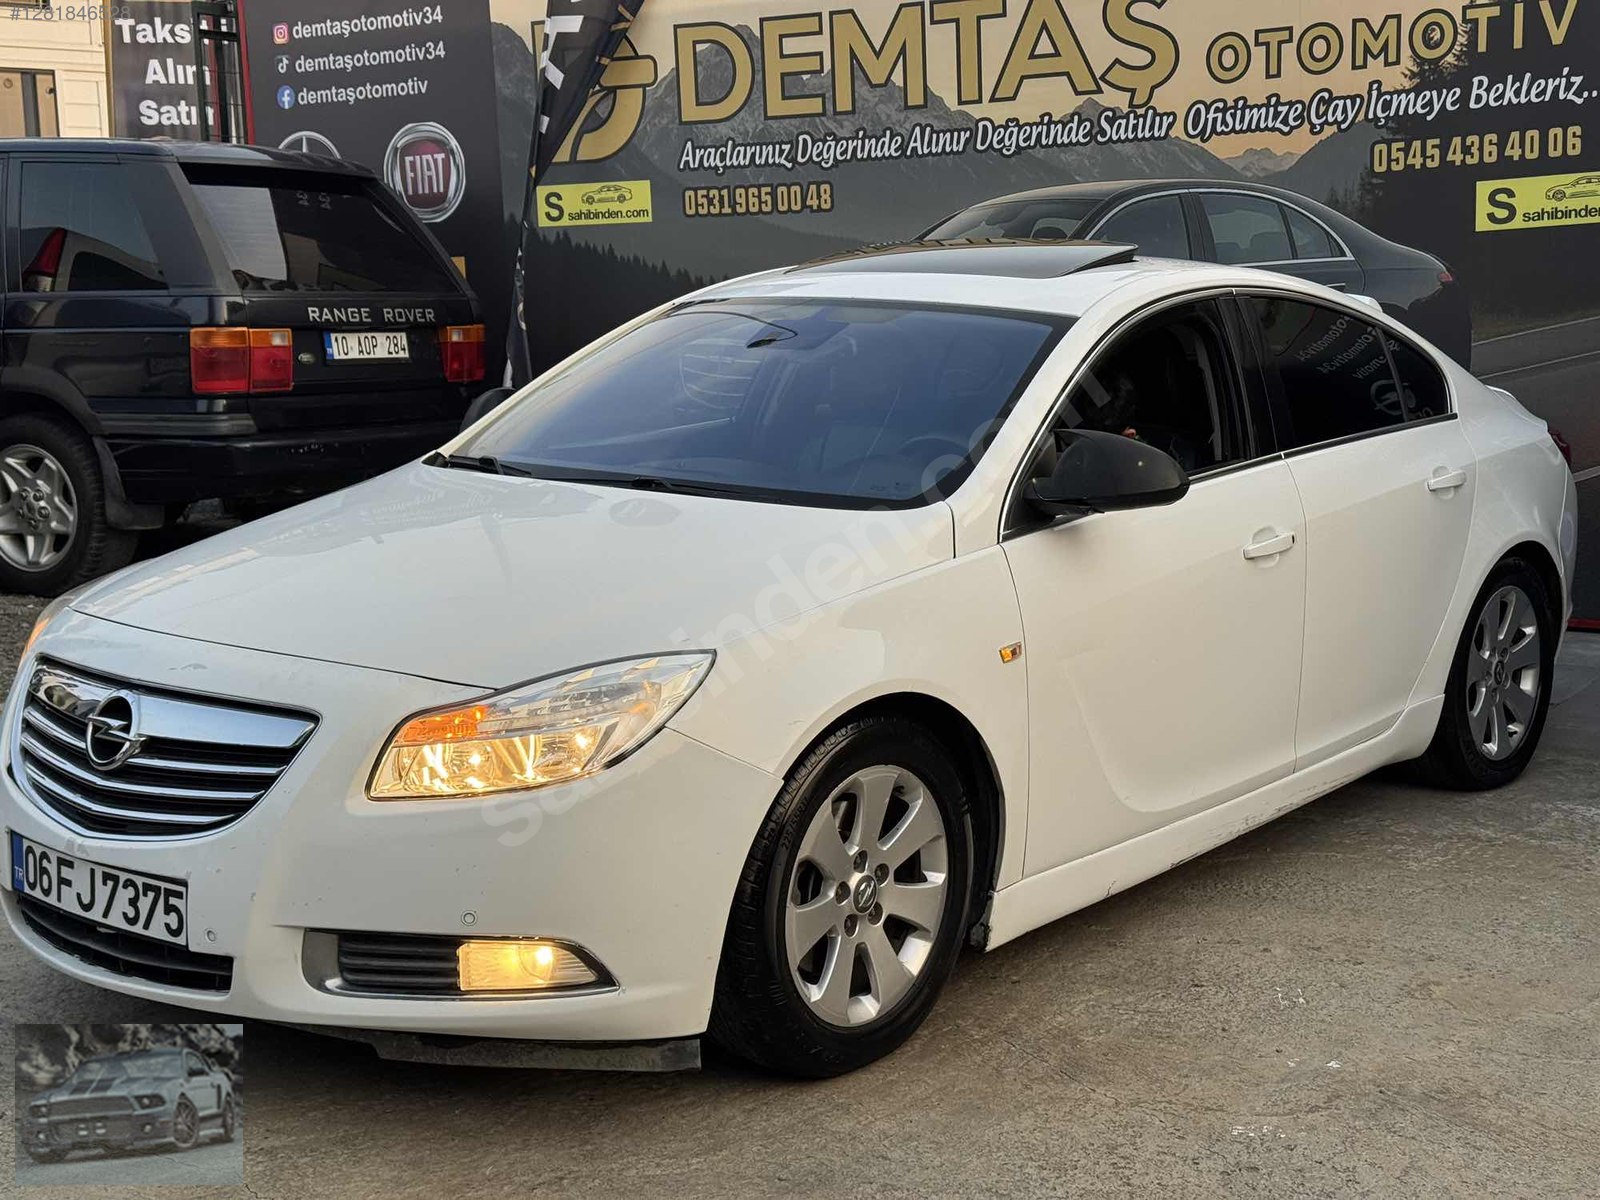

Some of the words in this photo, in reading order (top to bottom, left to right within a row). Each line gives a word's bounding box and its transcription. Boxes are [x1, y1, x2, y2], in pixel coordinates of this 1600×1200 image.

[292, 5, 443, 38] demtaşotomotiv34
[294, 41, 446, 72] demtaşotomotiv34
[673, 0, 1180, 125] DEMTAŞ
[297, 77, 428, 104] demtaşotomotiv
[679, 140, 793, 174] Araçlarınız
[796, 130, 901, 168] Değerinde
[906, 126, 970, 156] Alınır
[976, 116, 1091, 155] Değerinde
[1097, 109, 1174, 142] Satılır
[1187, 96, 1302, 140] Ofisimize
[1310, 91, 1361, 132] Çay
[1368, 83, 1461, 125] İçmeye
[1373, 138, 1441, 173] 0545
[1446, 133, 1498, 166] 436
[1504, 129, 1540, 160] 40
[1548, 125, 1582, 158] 06
[404, 153, 445, 195] FIAT
[568, 208, 649, 221] sahibinden.com
[684, 187, 731, 216] 0531
[735, 186, 772, 213] 965
[777, 185, 801, 212] 00
[806, 183, 831, 210] 48
[1522, 205, 1600, 222] sahibinde
[308, 307, 371, 322] RANGE
[383, 308, 436, 322] ROVER
[334, 335, 349, 356] 10
[385, 335, 407, 356] 284
